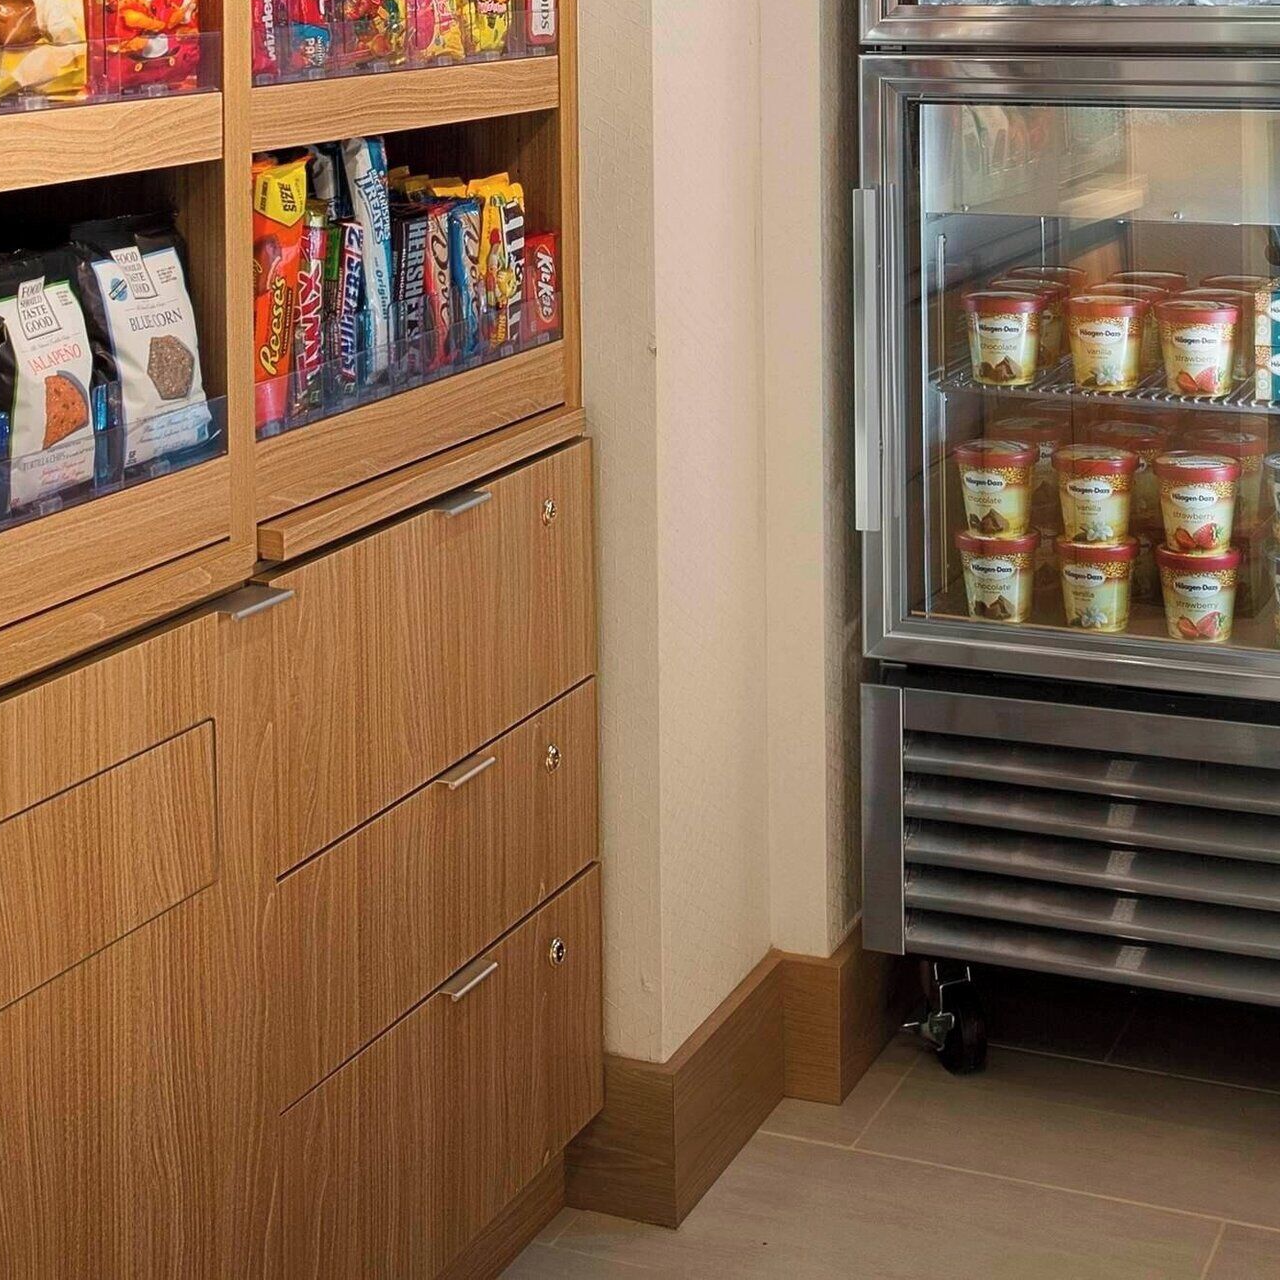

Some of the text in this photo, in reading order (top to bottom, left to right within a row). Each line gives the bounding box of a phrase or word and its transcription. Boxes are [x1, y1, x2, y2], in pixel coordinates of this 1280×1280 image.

[356, 172, 384, 244] TREATS
[115, 251, 138, 266] FOOD
[21, 282, 42, 297] FOOD
[21, 305, 49, 321] TASTE
[129, 308, 183, 332] BLUE CORN
[26, 317, 54, 333] GOOD
[27, 342, 83, 376] JALAPEÑO
